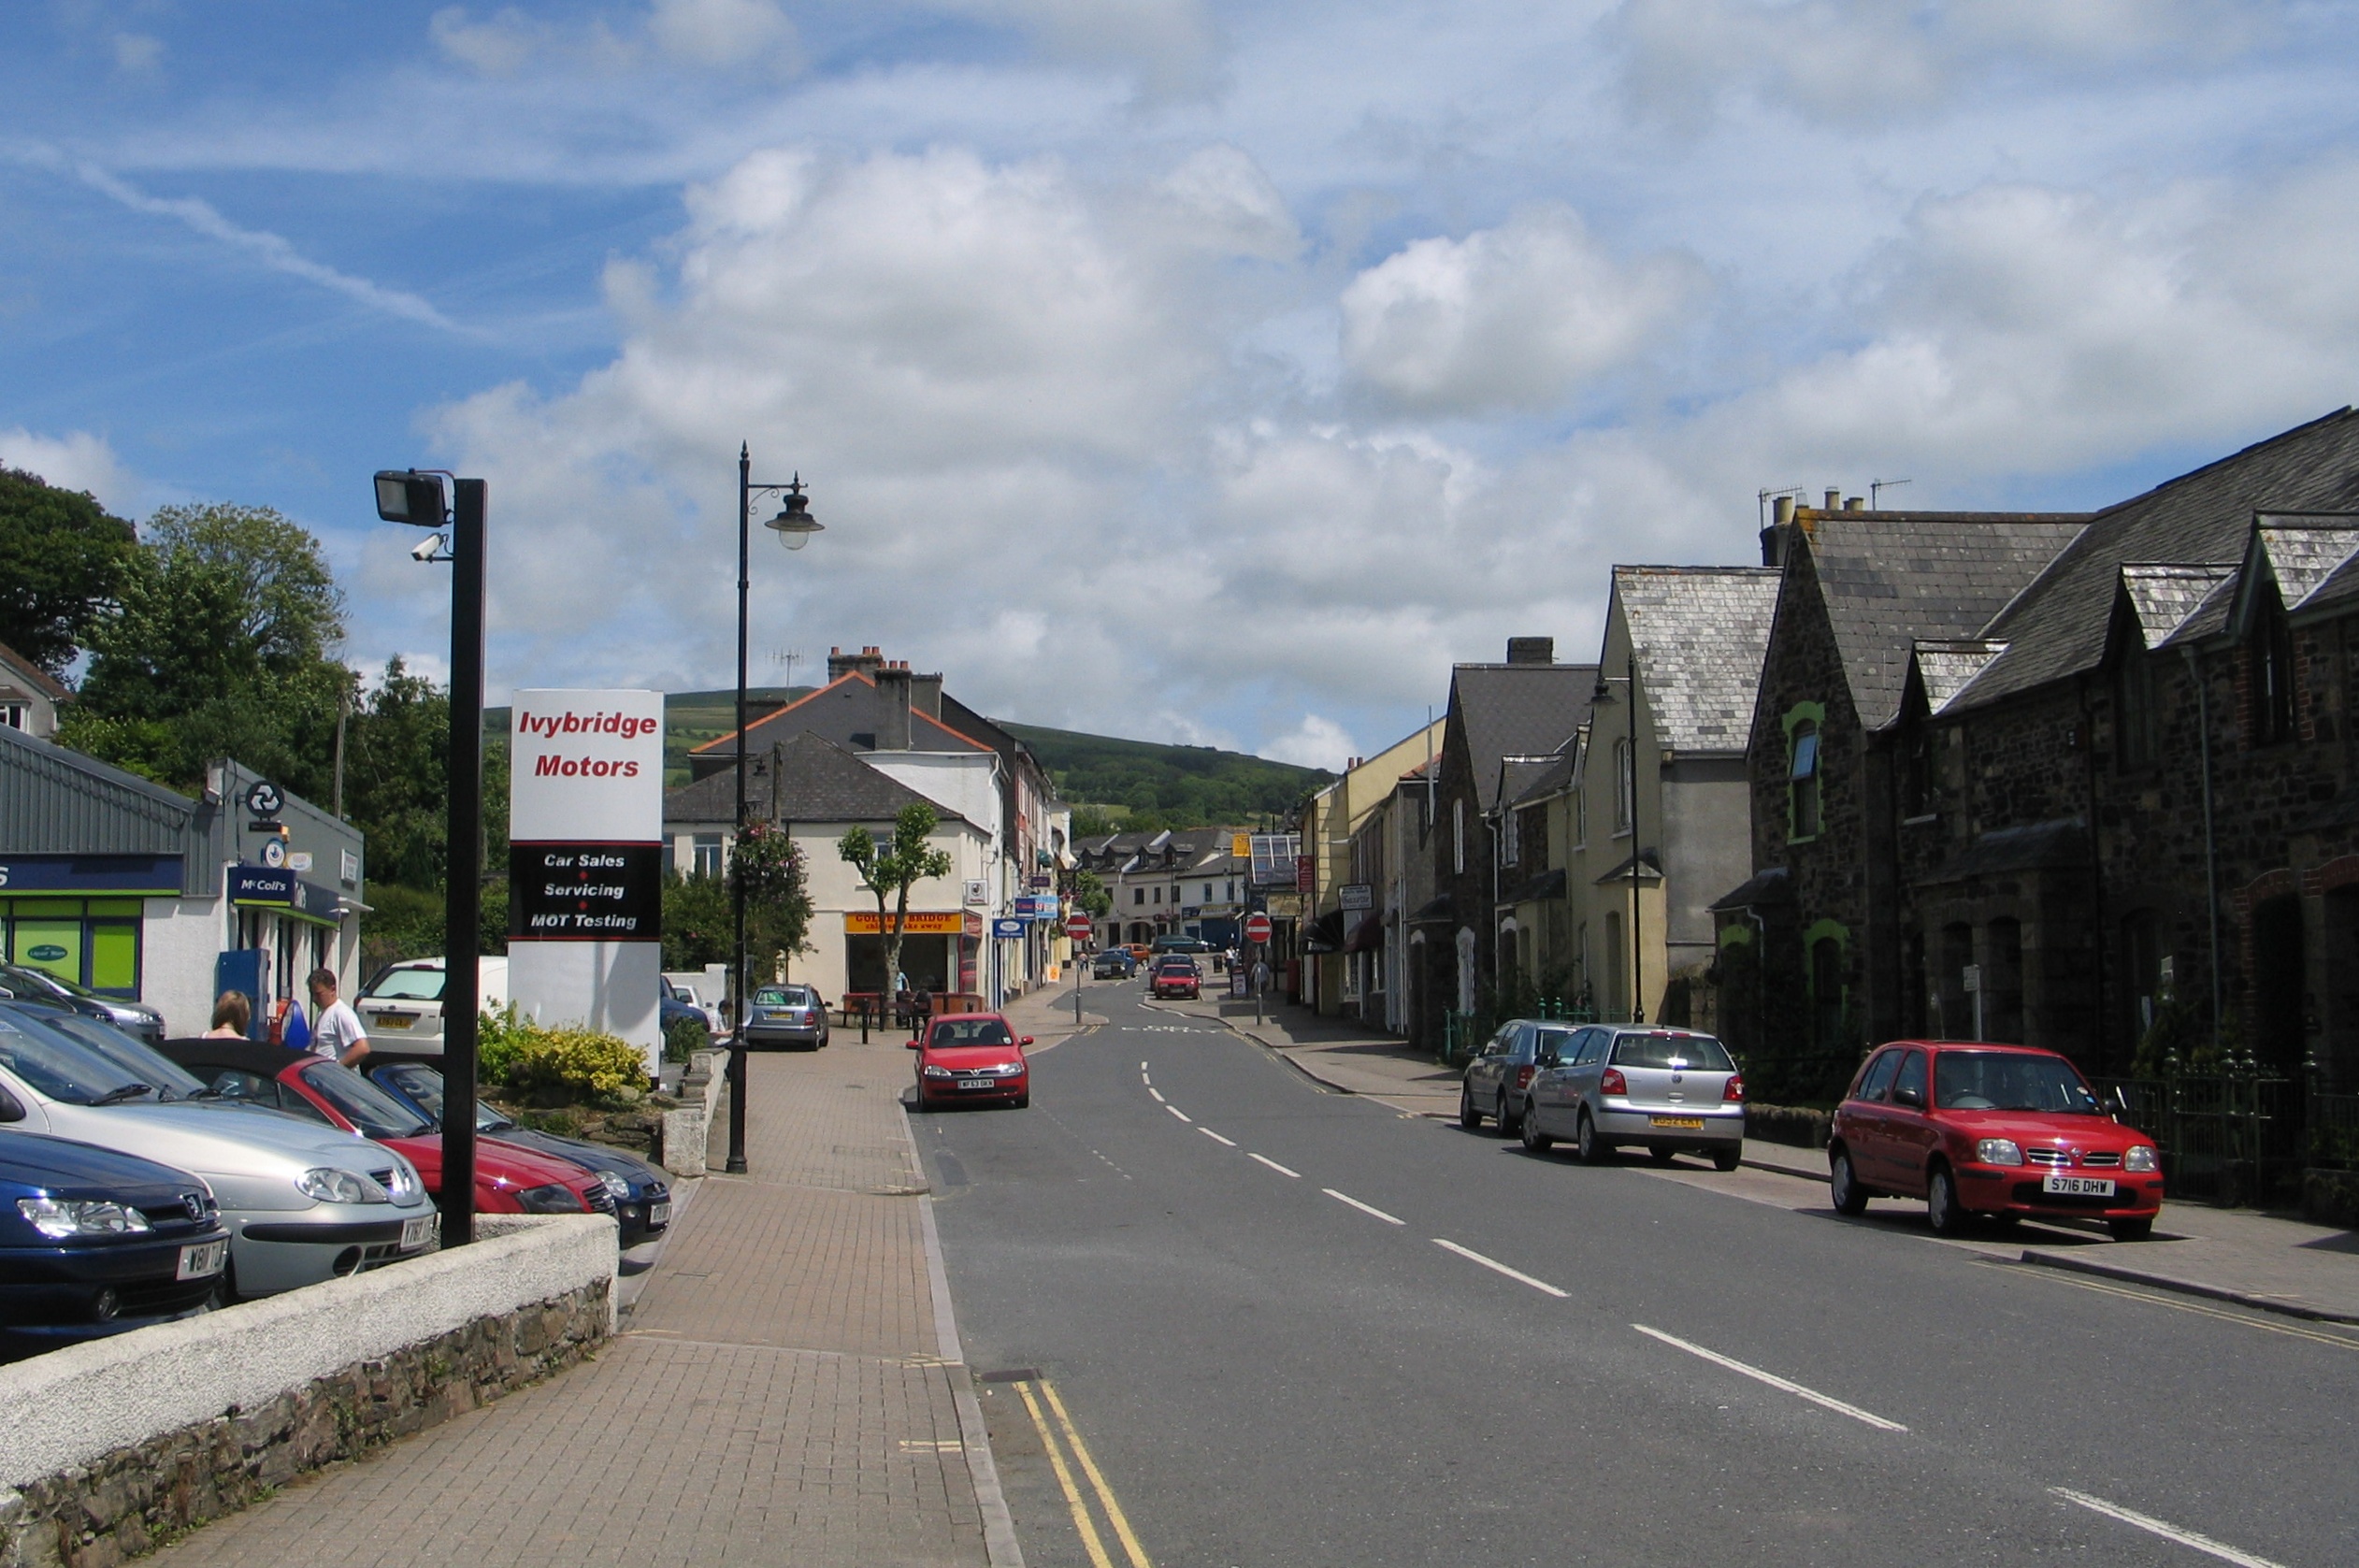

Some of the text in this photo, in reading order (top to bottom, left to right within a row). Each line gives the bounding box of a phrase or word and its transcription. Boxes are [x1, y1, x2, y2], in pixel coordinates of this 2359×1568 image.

[519, 712, 657, 739] Ivybridge
[535, 755, 640, 777] Motors
[544, 854, 626, 868] Car Sales
[544, 883, 625, 899] Servicing
[530, 913, 638, 930] MOT Testing
[2051, 1178, 2107, 1193] S716 DHW
